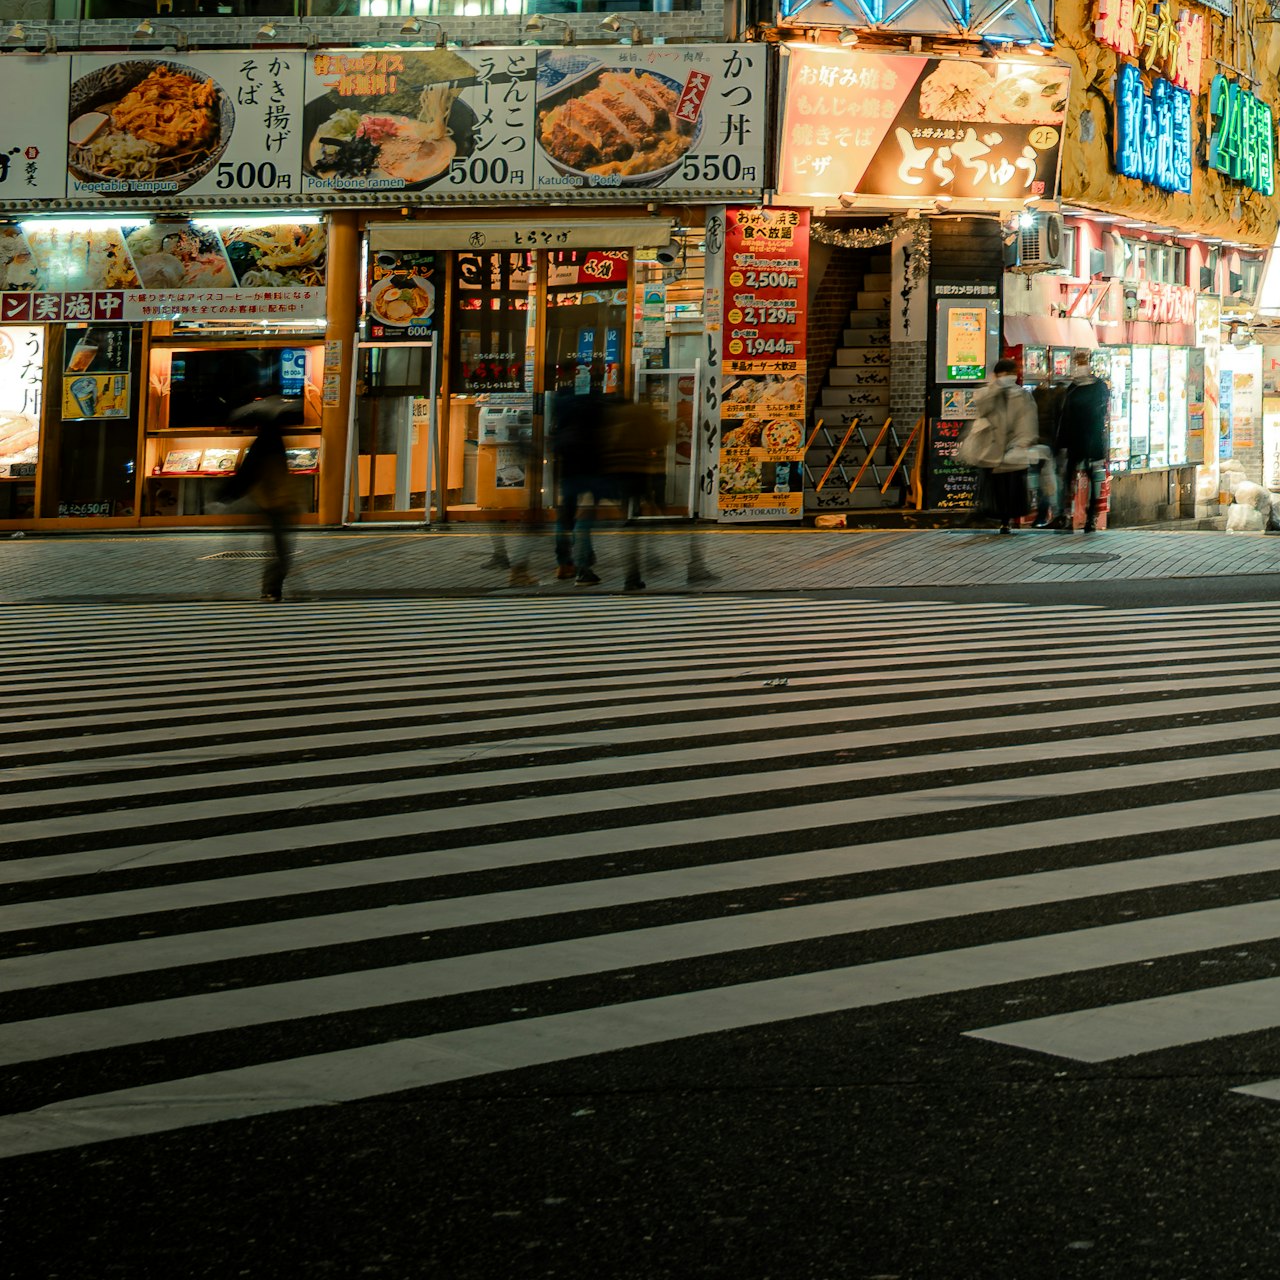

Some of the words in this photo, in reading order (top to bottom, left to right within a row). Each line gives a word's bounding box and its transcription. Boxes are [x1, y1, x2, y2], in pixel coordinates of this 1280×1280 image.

[236, 60, 263, 105] そば
[799, 64, 898, 91] お好み焼き
[264, 56, 291, 153] かき揚げ
[473, 57, 495, 152] ラーメン
[501, 55, 528, 153] とんこつ
[719, 49, 753, 147] かつ丼
[796, 97, 896, 119] もんじゃ焼き
[791, 124, 875, 148] 焼きそば
[911, 126, 966, 140] お好み焼き
[1035, 131, 1054, 144] 2F
[215, 161, 292, 189] 500円
[449, 156, 525, 185] 500円
[682, 154, 756, 182] 550円
[73, 179, 128, 194] Vegetable
[130, 179, 178, 193] Tempura
[307, 176, 334, 188] Pork
[336, 176, 365, 188] bone
[367, 177, 405, 188] ramen
[538, 174, 583, 187] Katudon
[588, 173, 623, 187] (Pork)
[514, 230, 572, 245] とらそば
[743, 226, 793, 239] 食べ放題
[745, 271, 797, 289] 2,500円
[2, 293, 124, 320] ン実施中
[744, 307, 797, 326] 2,129円
[745, 338, 795, 356] 1,944円
[731, 361, 797, 371] 単品オーダー大歓迎
[701, 332, 720, 495] とらそば
[750, 508, 787, 516] TORADYU
